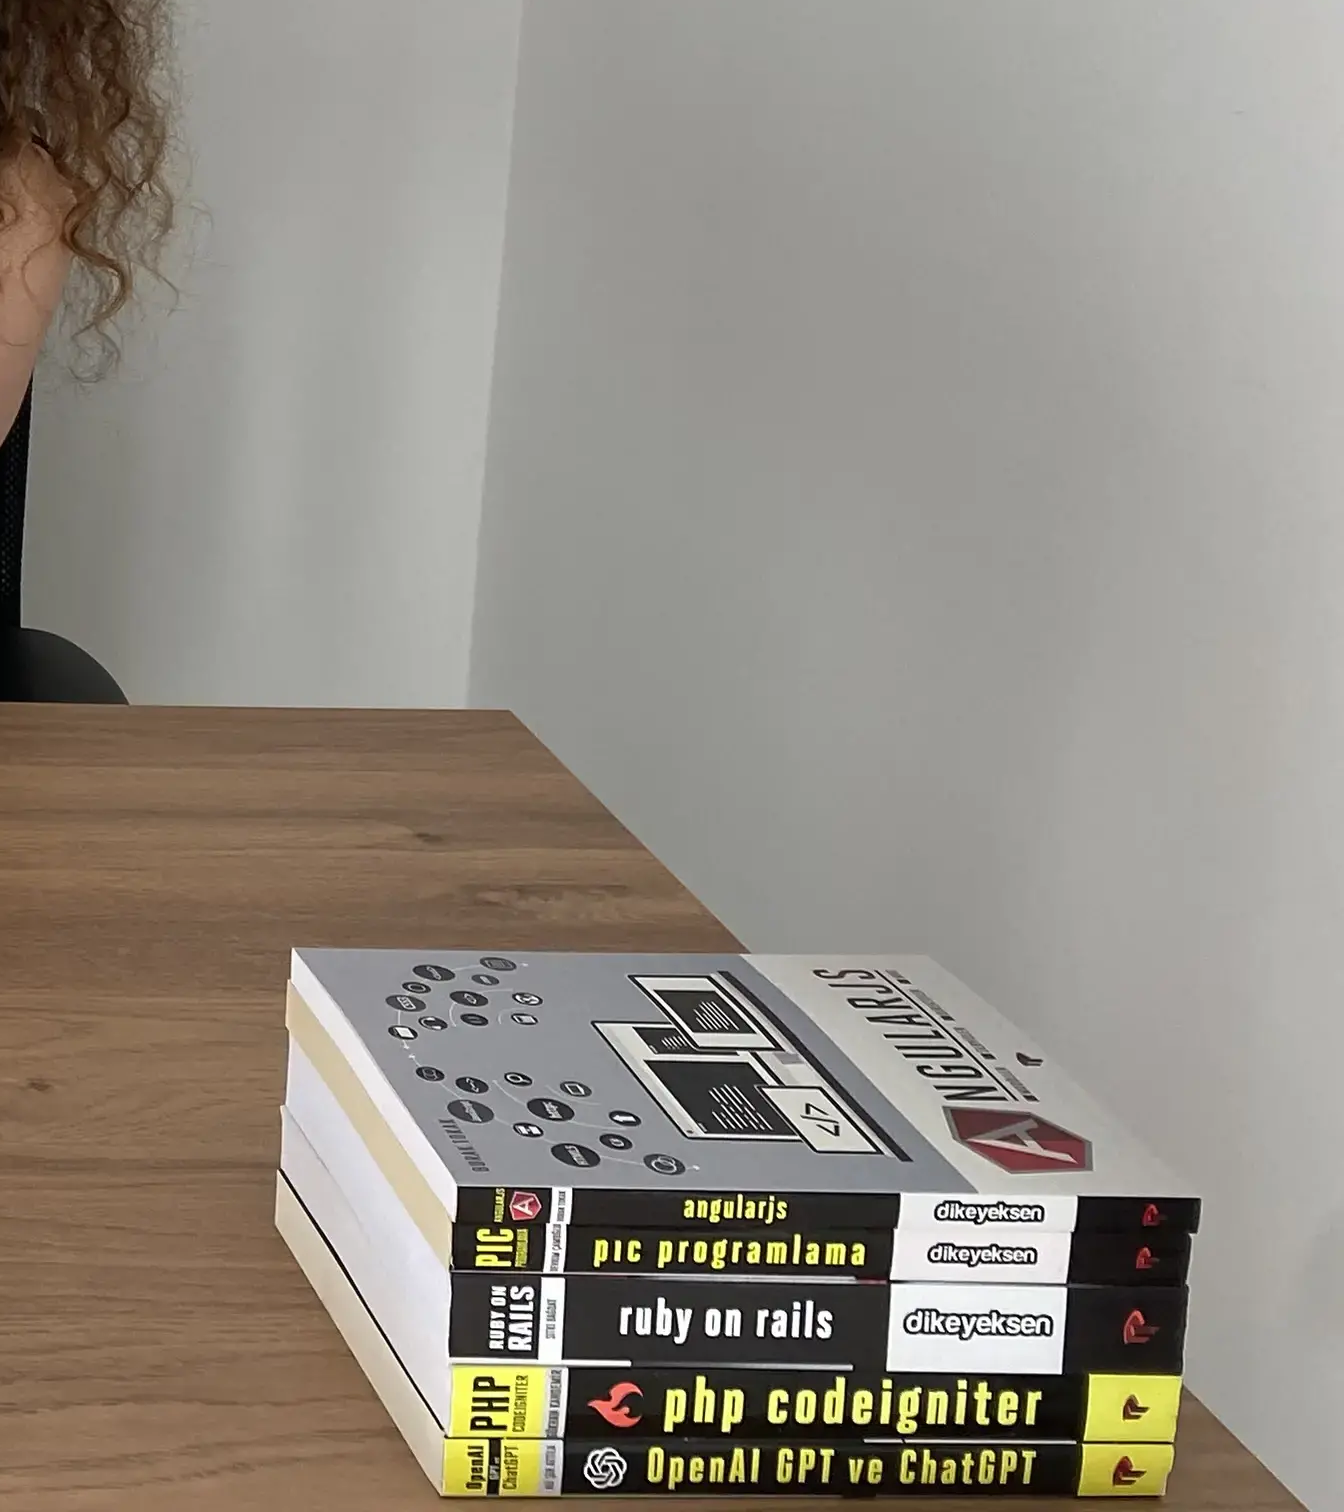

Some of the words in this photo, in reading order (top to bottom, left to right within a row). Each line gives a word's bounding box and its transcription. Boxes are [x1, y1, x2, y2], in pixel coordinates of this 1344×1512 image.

[683, 1194, 788, 1224] angularjs
[934, 1200, 1046, 1225] dikeyeksen
[475, 1228, 514, 1268] PIC
[657, 1234, 866, 1269] programlama
[927, 1242, 1038, 1268] dikeyeksen
[489, 1285, 507, 1305] ON
[488, 1309, 506, 1350] RUBY
[506, 1285, 535, 1352] RAILS
[619, 1297, 693, 1345] ruby
[704, 1308, 742, 1338] on
[756, 1300, 833, 1339] rails
[902, 1308, 1054, 1340] dikeyeksen
[470, 1375, 510, 1432] PHP
[512, 1374, 529, 1433] CODEIGNITER
[663, 1375, 745, 1433] php
[767, 1376, 1043, 1434] codeigniter
[465, 1445, 486, 1490] OpenAI
[502, 1445, 519, 1490] ChatGPT
[647, 1446, 760, 1490] OpenAI
[776, 1448, 836, 1484] GPT
[848, 1458, 884, 1485] ve
[899, 1449, 1038, 1485] ChatGPT
